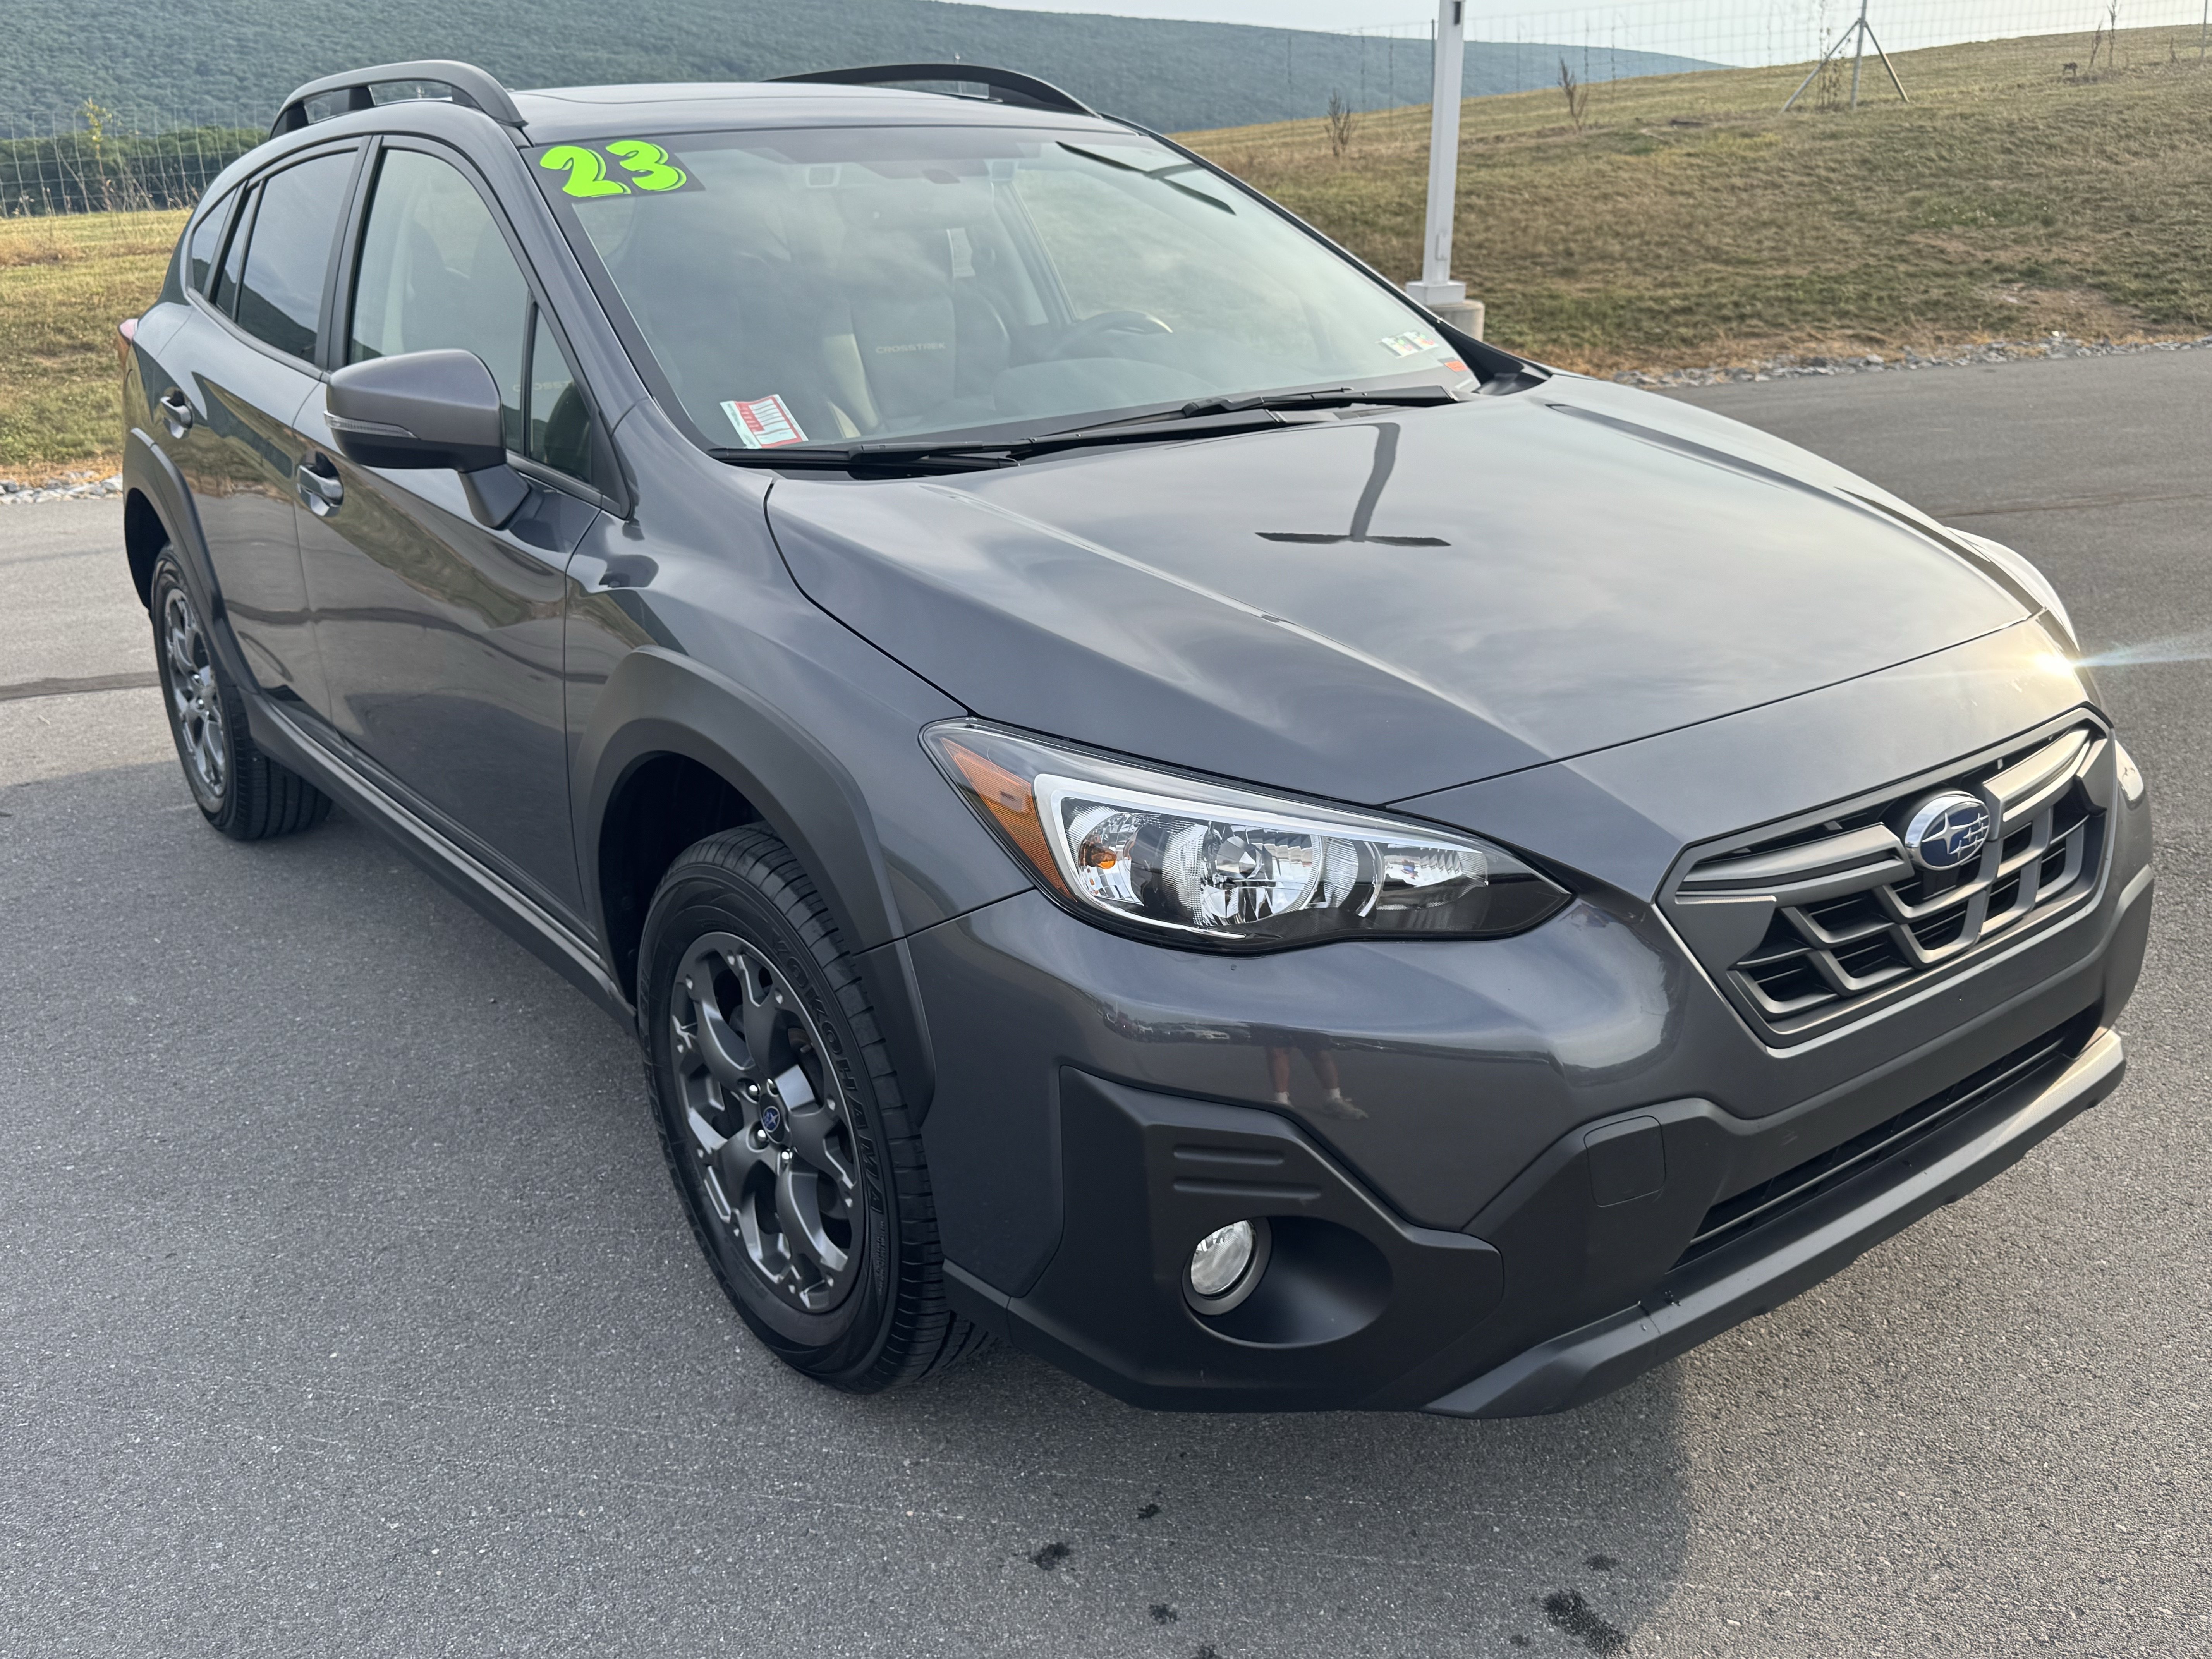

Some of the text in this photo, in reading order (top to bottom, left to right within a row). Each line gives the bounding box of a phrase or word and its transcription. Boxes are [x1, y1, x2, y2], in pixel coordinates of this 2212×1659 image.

[540, 140, 687, 198] 23
[876, 343, 946, 354] CROSSTREK
[772, 927, 884, 1215] YOKOHAMA
